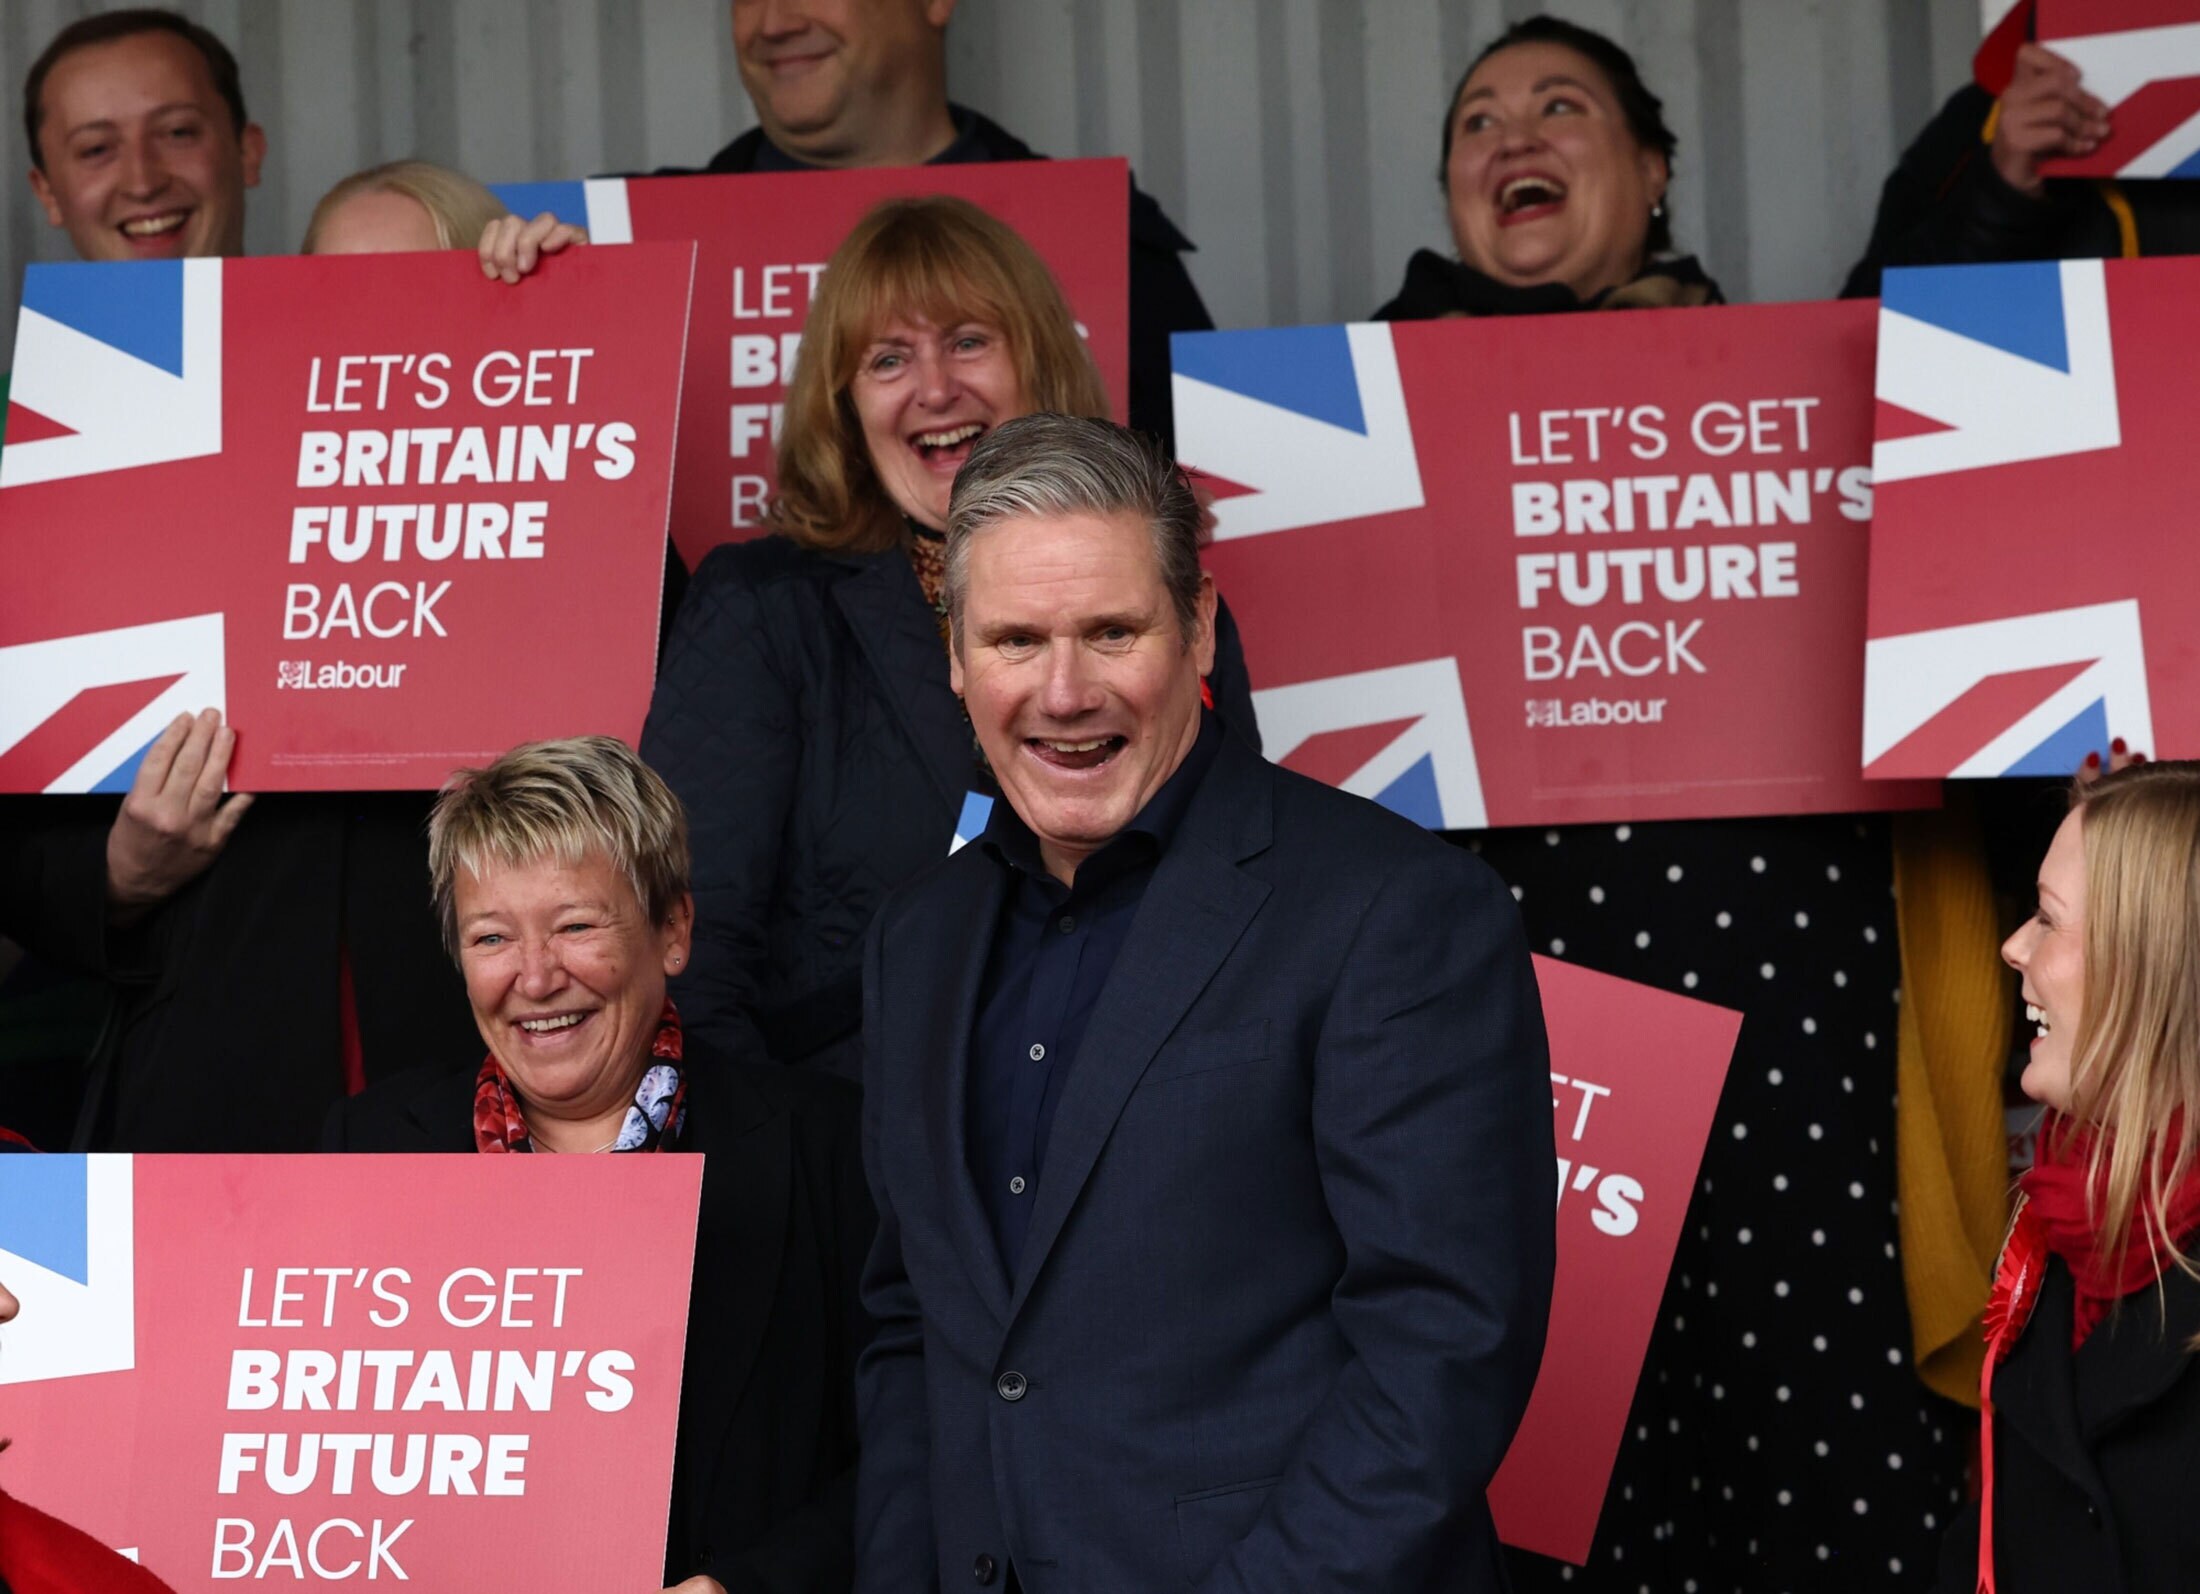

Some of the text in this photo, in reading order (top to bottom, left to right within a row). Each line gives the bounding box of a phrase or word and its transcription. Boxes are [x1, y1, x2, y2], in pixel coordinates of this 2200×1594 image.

[734, 264, 827, 318] LET
[307, 349, 594, 412] LET'S GET
[297, 422, 636, 487] BRITAIN'S
[1510, 398, 1818, 465] LET'S GET
[289, 501, 548, 563] FUTURE
[1512, 466, 1873, 537] BRITAIN'S
[1517, 542, 1799, 608] FUTURE
[283, 581, 451, 639] BACK
[303, 660, 406, 689] Labour
[1523, 619, 1706, 680] BACK
[1554, 698, 1666, 726] Labour
[239, 1268, 583, 1327] LET'S GET
[227, 1350, 635, 1412] BRITAIN'S
[218, 1434, 529, 1495] FUTURE
[212, 1519, 414, 1579] BACK
